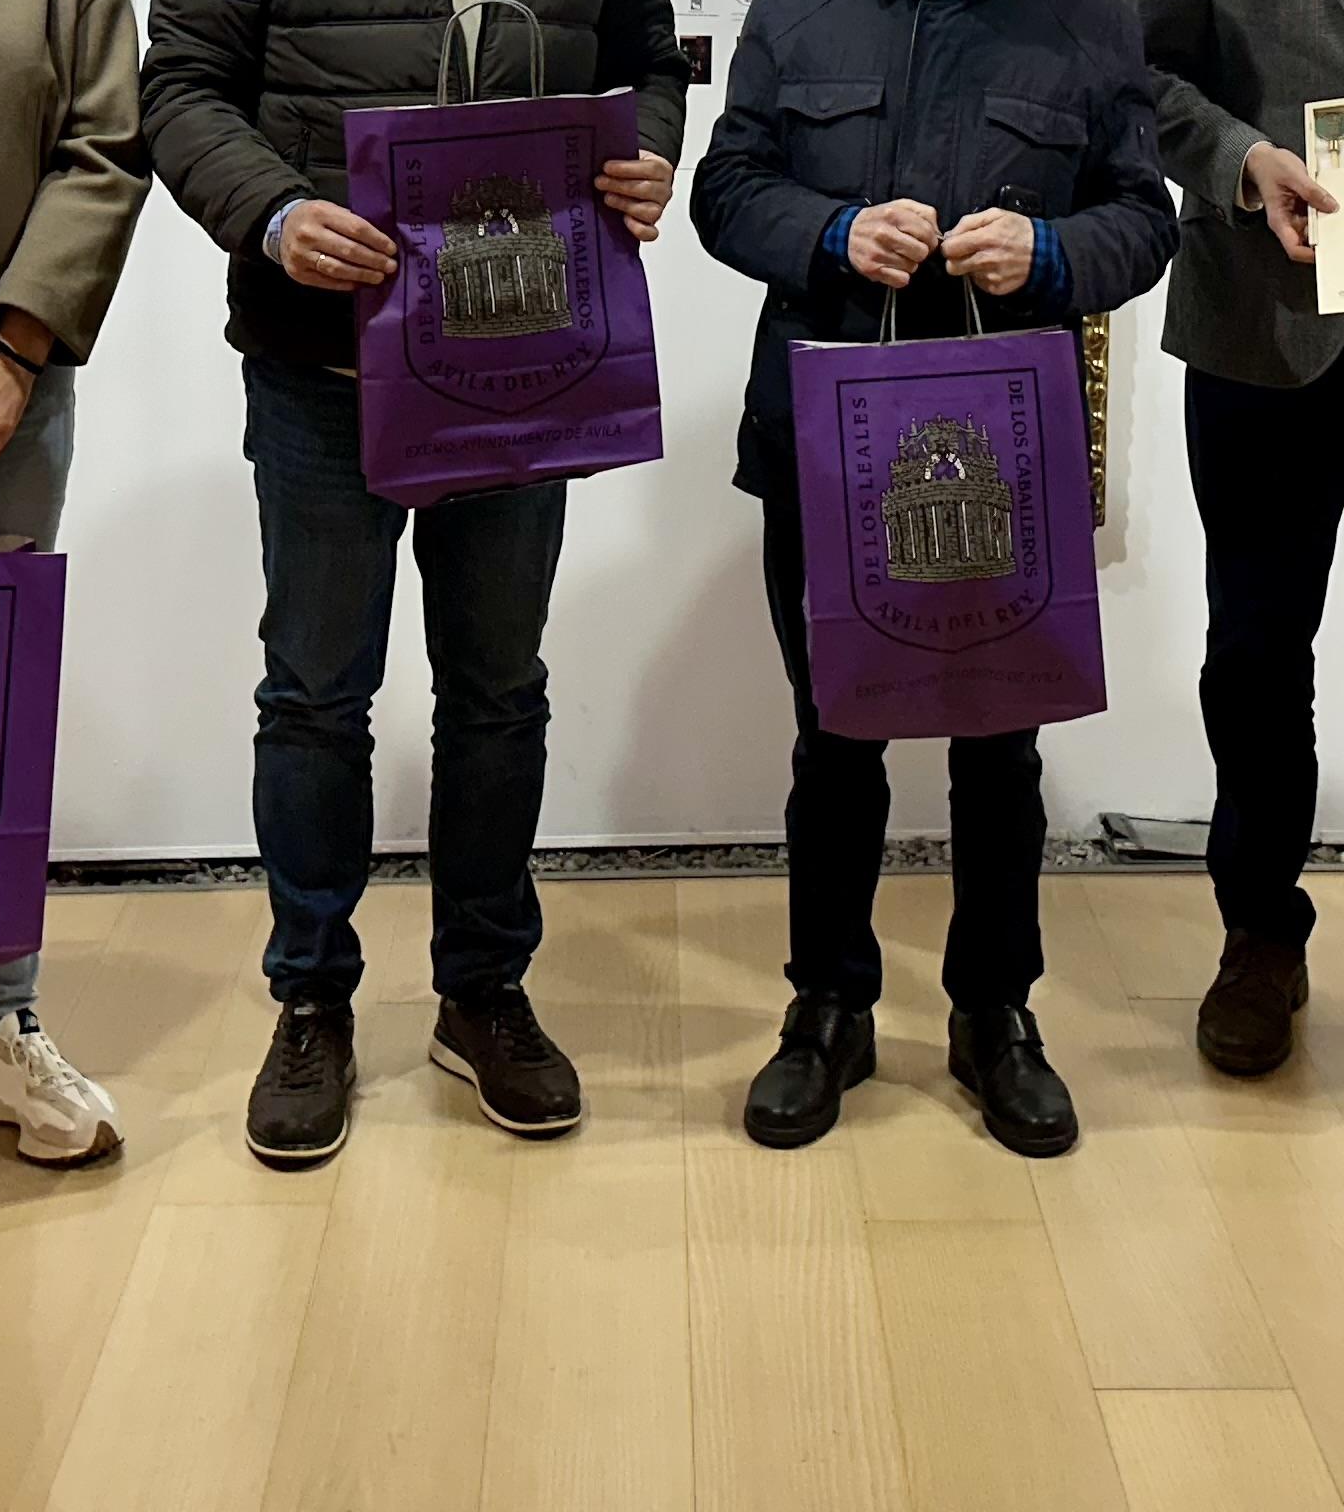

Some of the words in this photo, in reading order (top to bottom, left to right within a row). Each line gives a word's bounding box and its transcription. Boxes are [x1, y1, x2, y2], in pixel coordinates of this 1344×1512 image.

[565, 134, 581, 161] DE
[404, 156, 427, 249] LEALES
[564, 165, 584, 200] LOS
[416, 257, 435, 306] LOS
[567, 205, 597, 333] CABALLEROS
[420, 310, 437, 346] DE
[502, 367, 549, 394] DEL
[550, 341, 596, 380] REY
[1008, 378, 1025, 407] DE
[563, 427, 584, 443] DE
[583, 424, 624, 441] AVILA
[852, 396, 875, 491] LEALES
[1011, 410, 1029, 450] LOS
[860, 500, 878, 550] LOS
[1015, 452, 1040, 580] CABALLEROS
[865, 553, 882, 588] DE
[874, 600, 941, 633] AVILA
[997, 587, 1036, 624] REY
